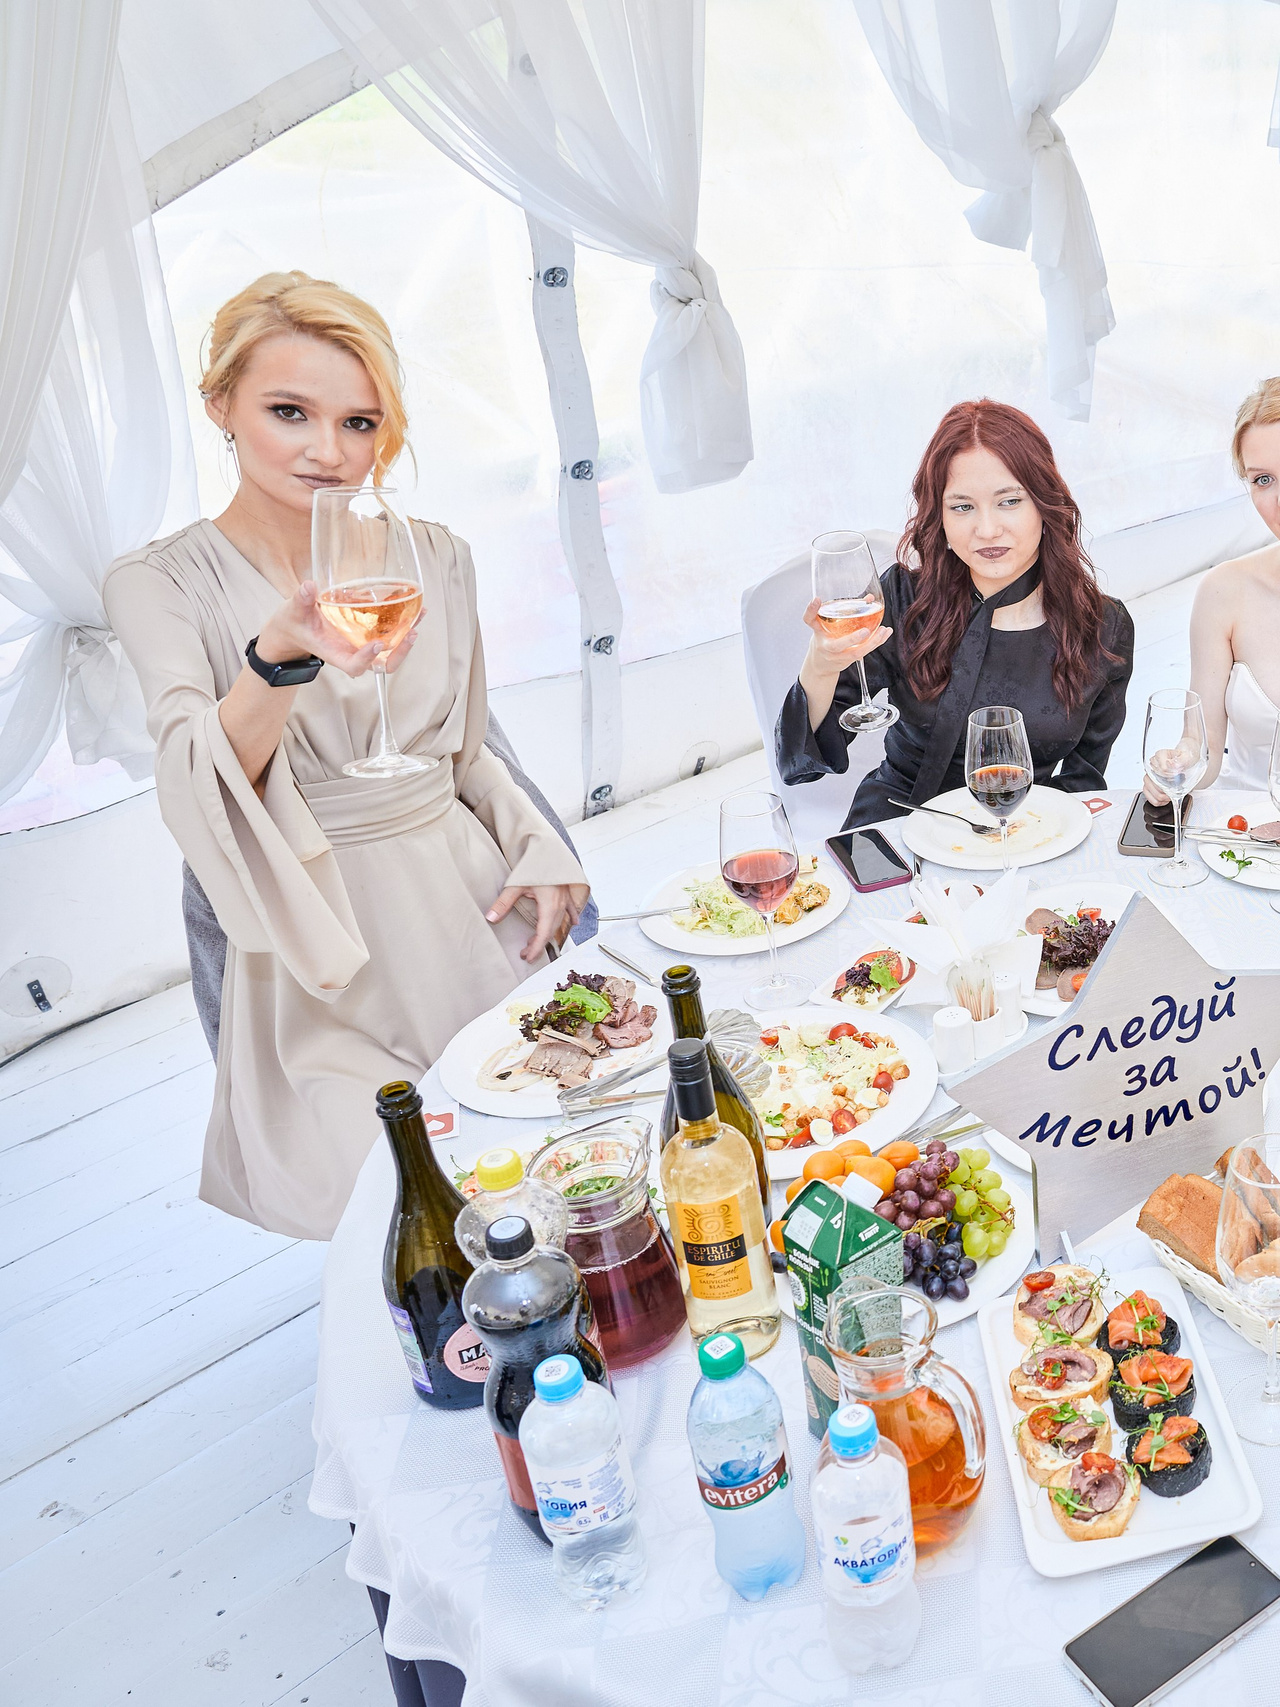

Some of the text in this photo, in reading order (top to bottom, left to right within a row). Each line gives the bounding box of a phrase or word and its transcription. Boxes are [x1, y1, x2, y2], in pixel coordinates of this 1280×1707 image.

[1048, 976, 1236, 1071] Следуй
[1123, 1055, 1178, 1096] за
[687, 1239, 741, 1255] ESPIRITU
[693, 1251, 736, 1262] DE CHILE
[699, 1275, 739, 1285] SAUVIGNON
[704, 1471, 779, 1506] evitera
[833, 1535, 908, 1569] АКВАТОРИЯ
